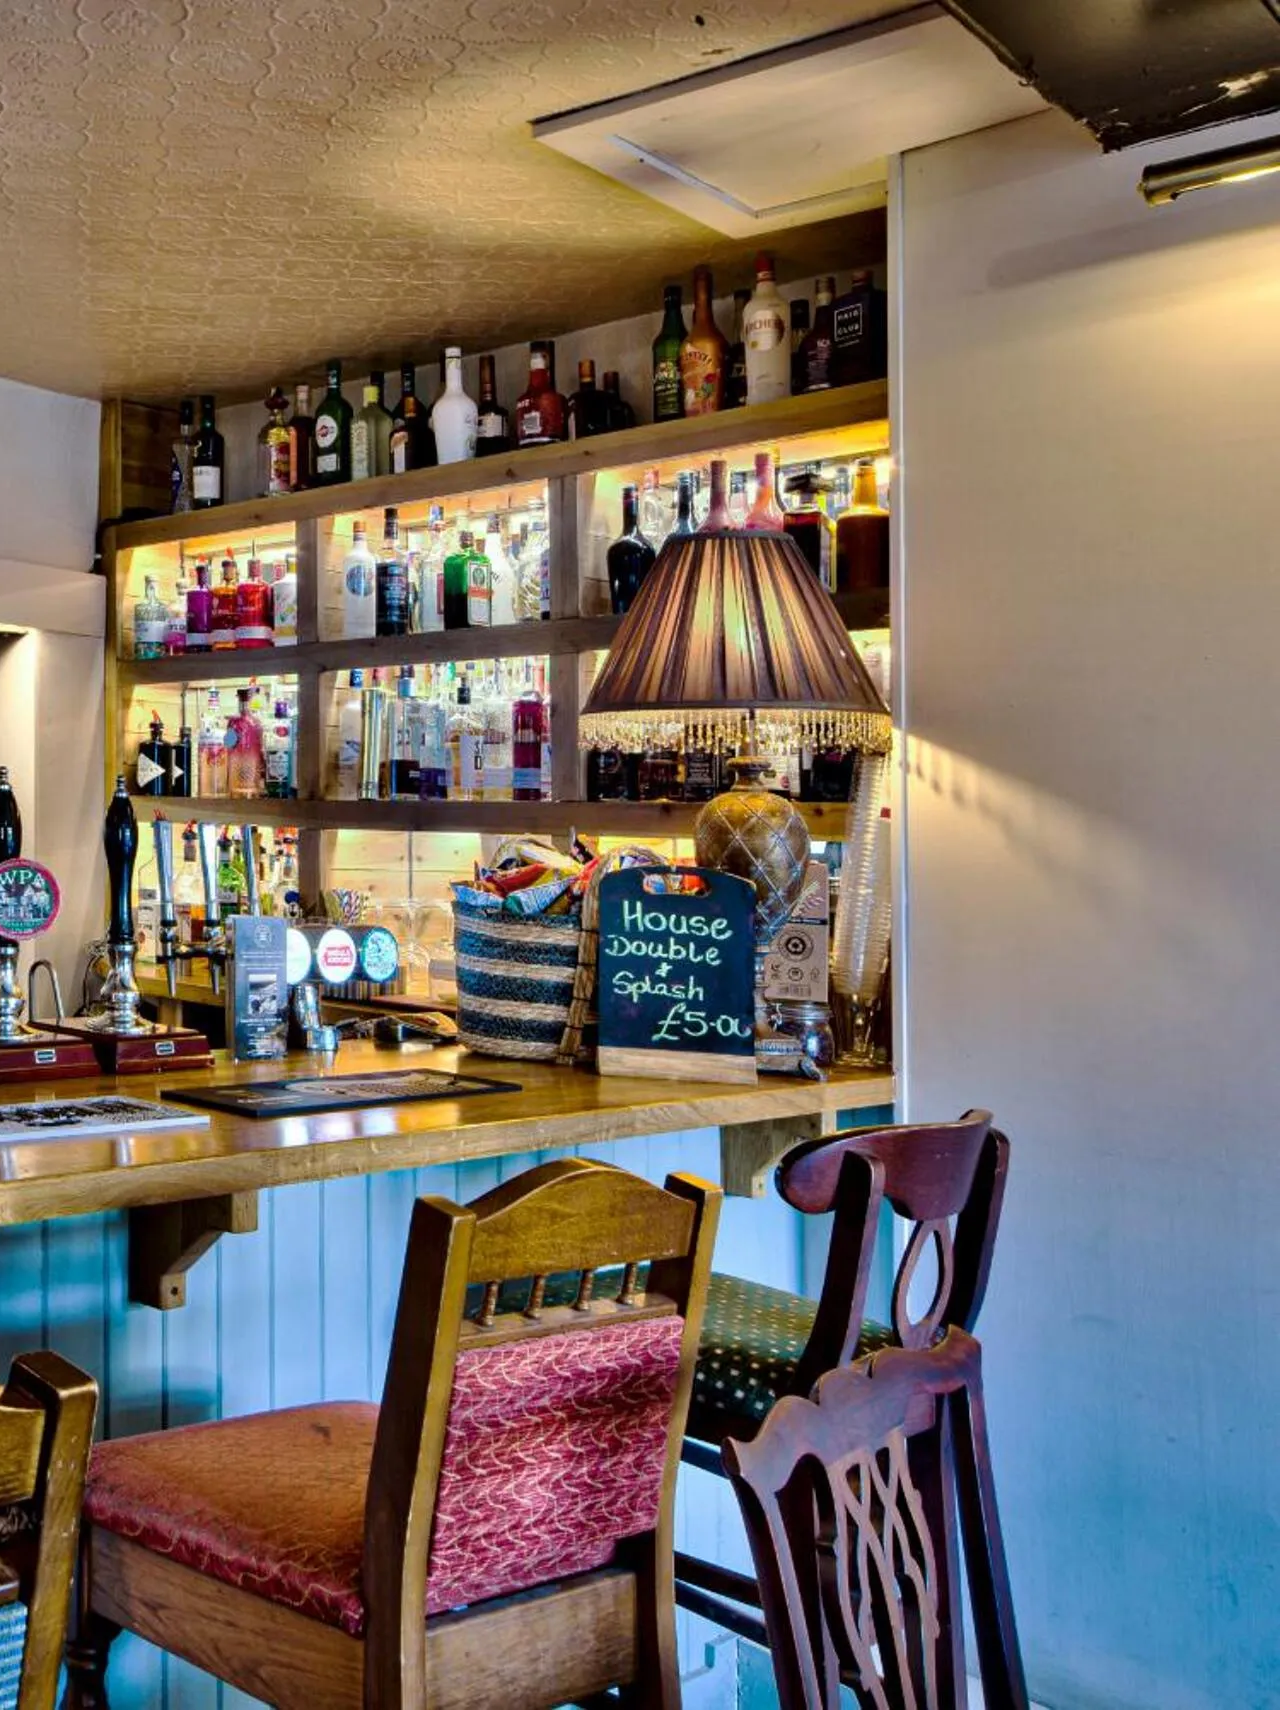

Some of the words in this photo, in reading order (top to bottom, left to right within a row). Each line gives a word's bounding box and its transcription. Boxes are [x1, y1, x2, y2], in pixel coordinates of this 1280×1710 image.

[837, 323, 860, 336] CLUB
[623, 900, 733, 940] House
[605, 935, 722, 966] Double
[612, 970, 704, 1003] Splash
